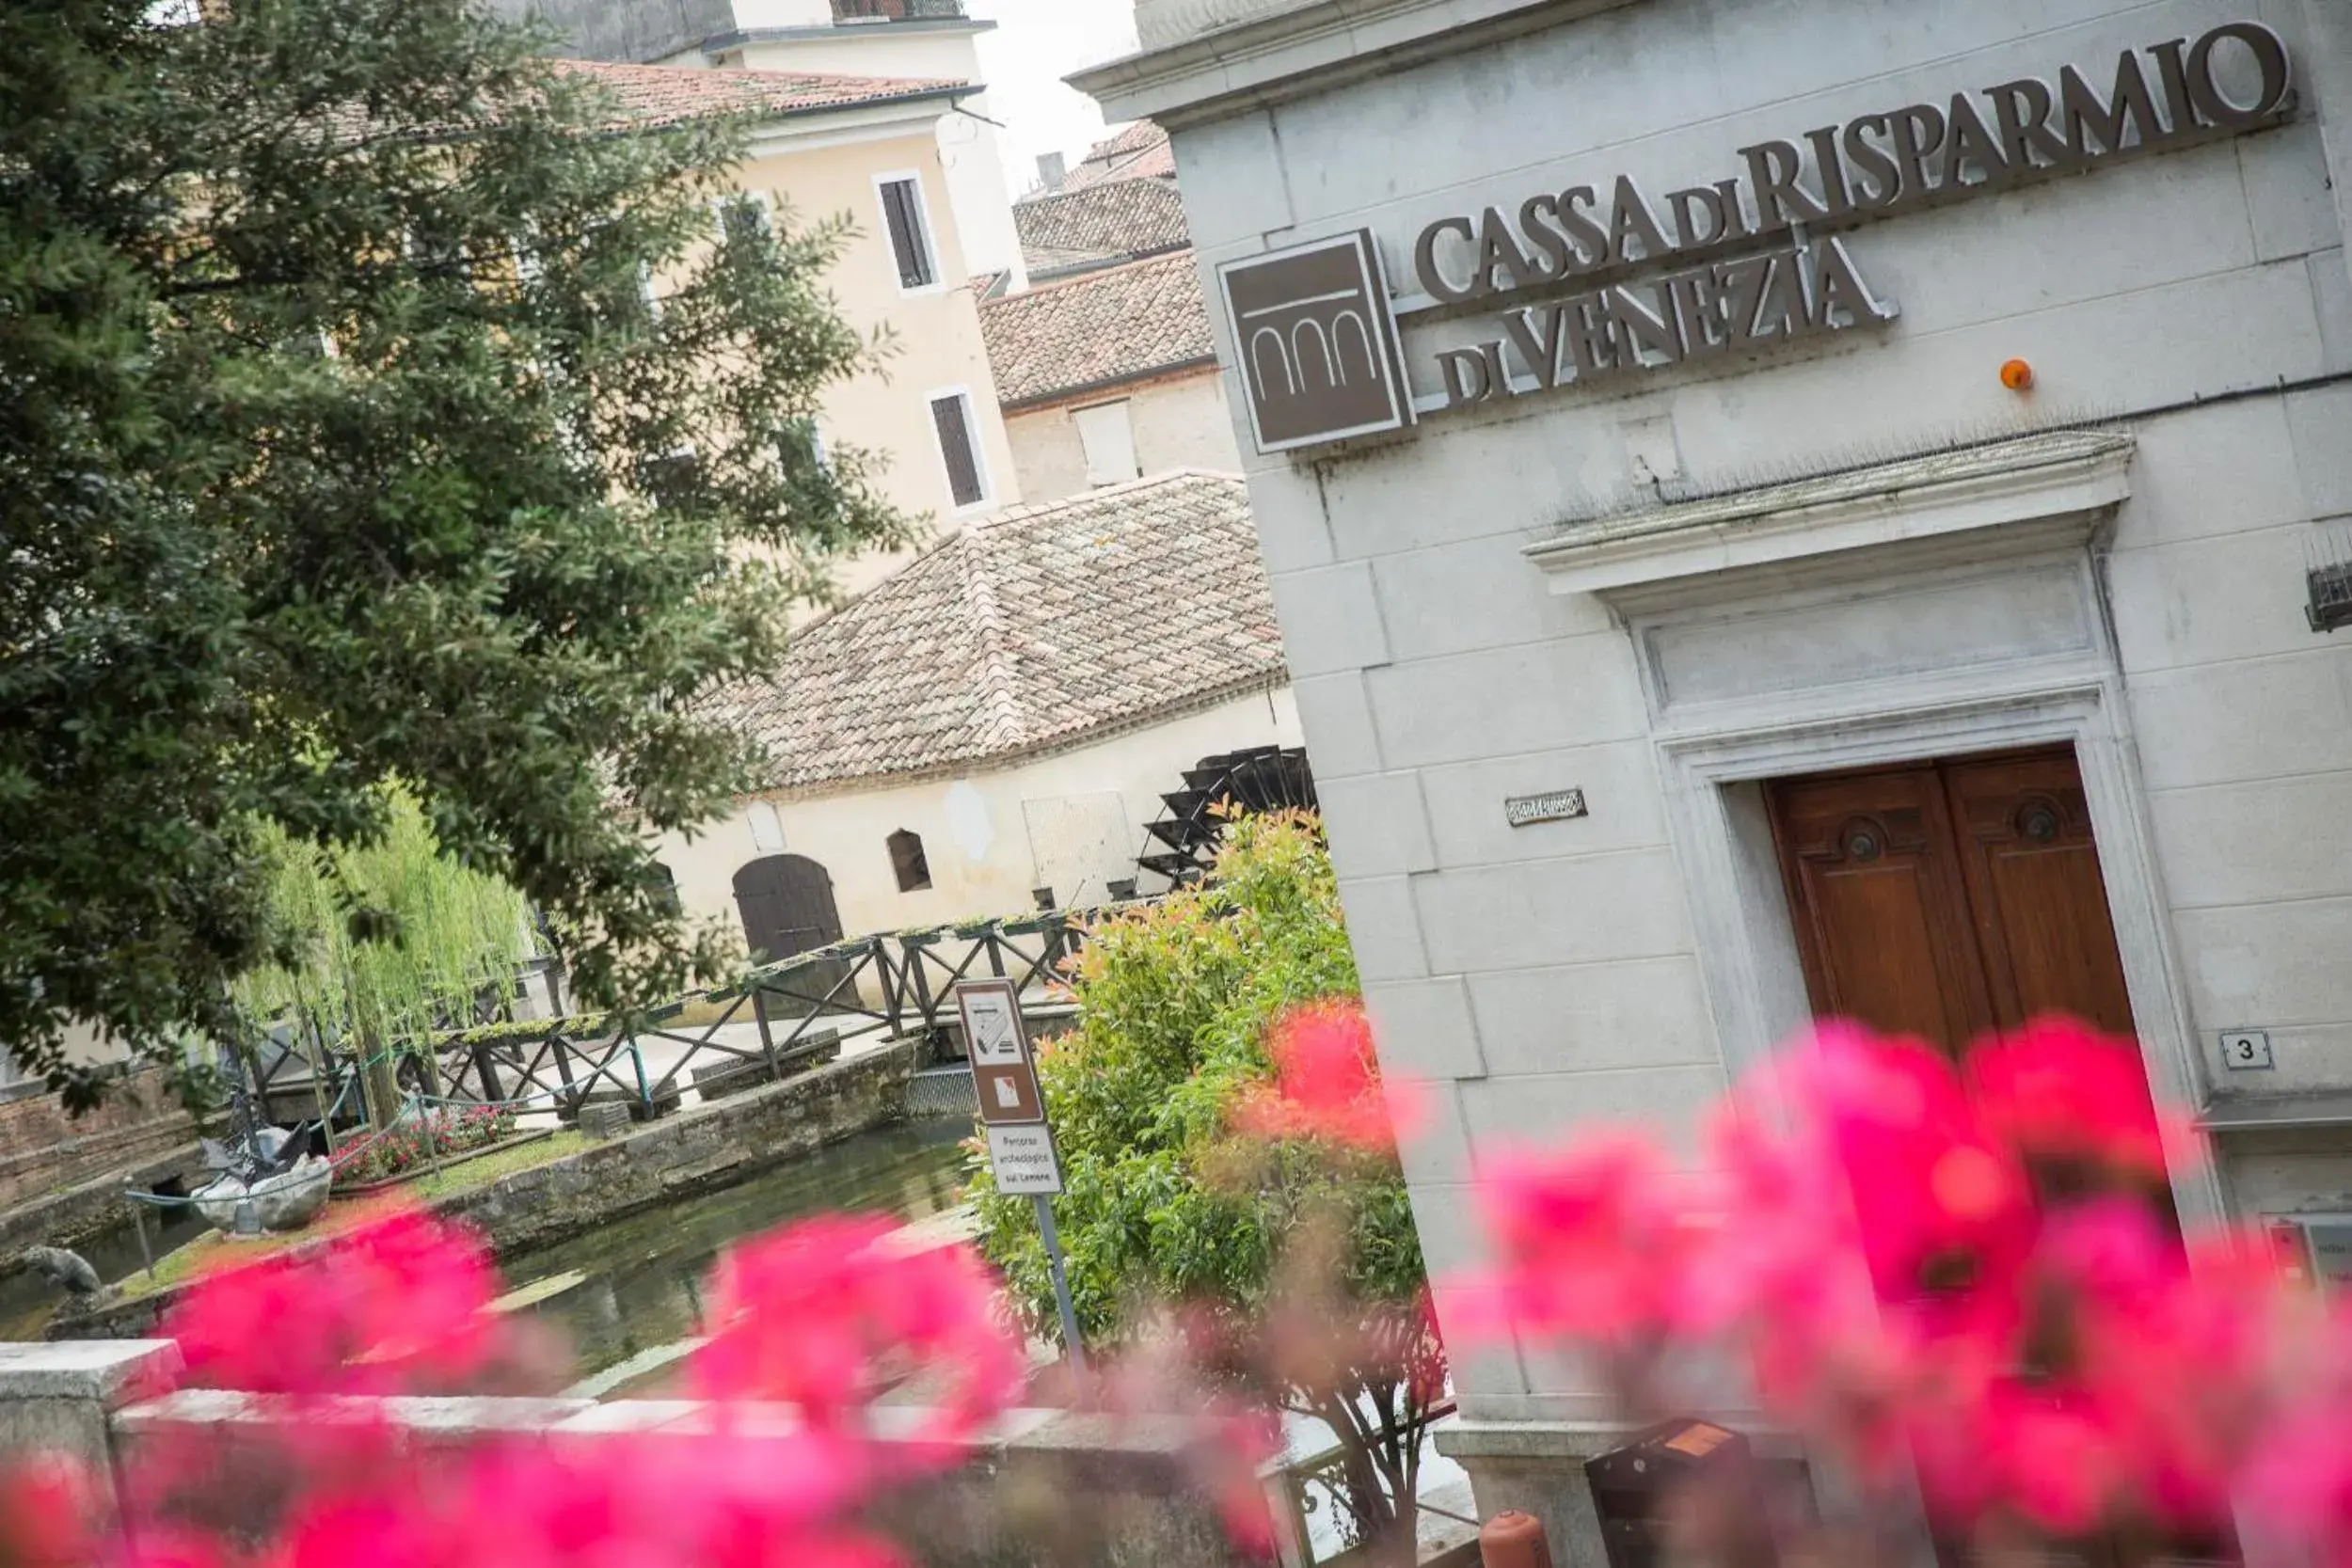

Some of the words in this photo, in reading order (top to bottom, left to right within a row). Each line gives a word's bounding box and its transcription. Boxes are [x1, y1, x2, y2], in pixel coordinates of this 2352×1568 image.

[1415, 174, 1678, 305] CASSA
[1666, 177, 1757, 251] DI
[1738, 21, 2292, 231] RISPARMIO
[1435, 340, 1519, 407] DI
[1505, 235, 1901, 388] VENEZIA
[2237, 1038, 2255, 1060] 3
